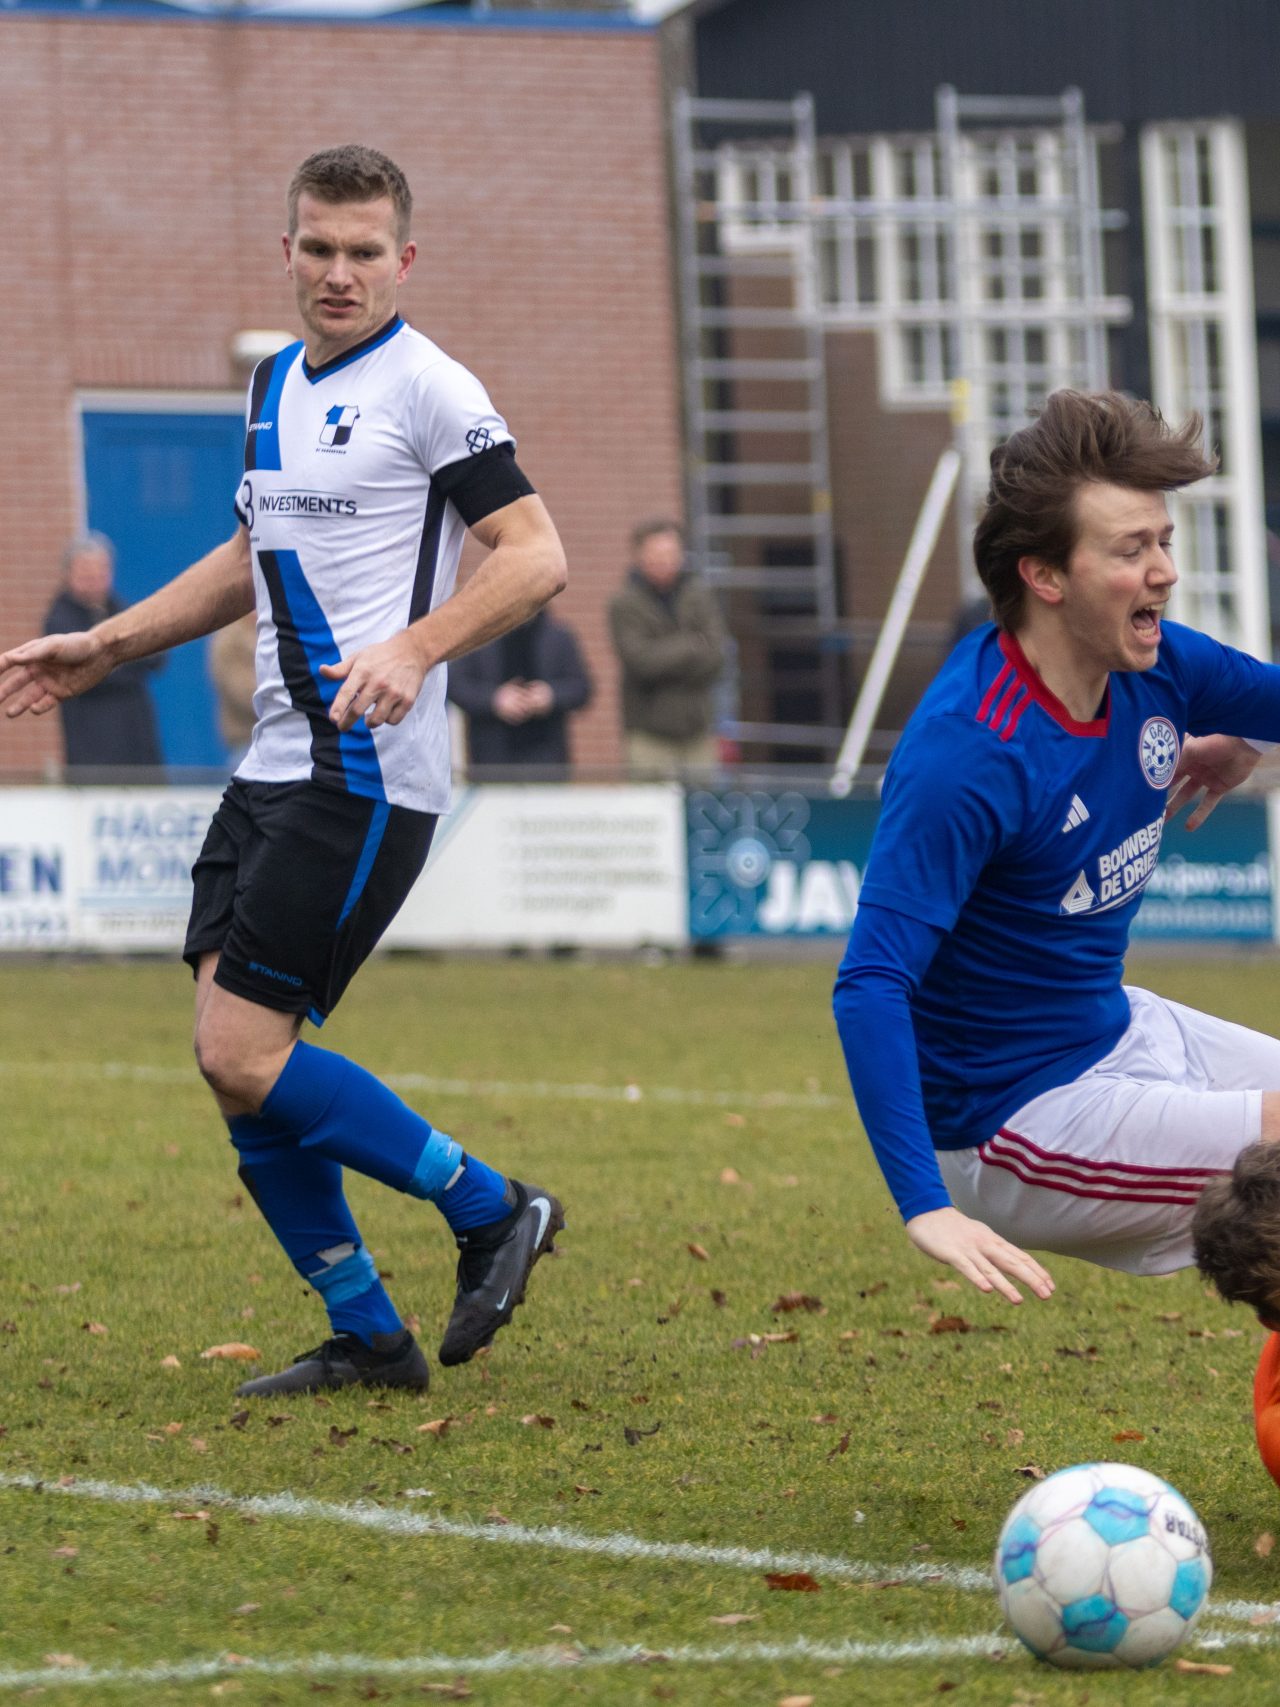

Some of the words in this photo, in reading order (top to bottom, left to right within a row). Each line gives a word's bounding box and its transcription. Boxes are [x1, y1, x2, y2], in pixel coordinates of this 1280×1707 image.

[259, 495, 358, 516] INVESTMENTS
[1149, 724, 1175, 751] GROL
[1101, 872, 1123, 903] DE
[249, 961, 303, 987] STANNO
[1164, 1512, 1208, 1550] STAR
